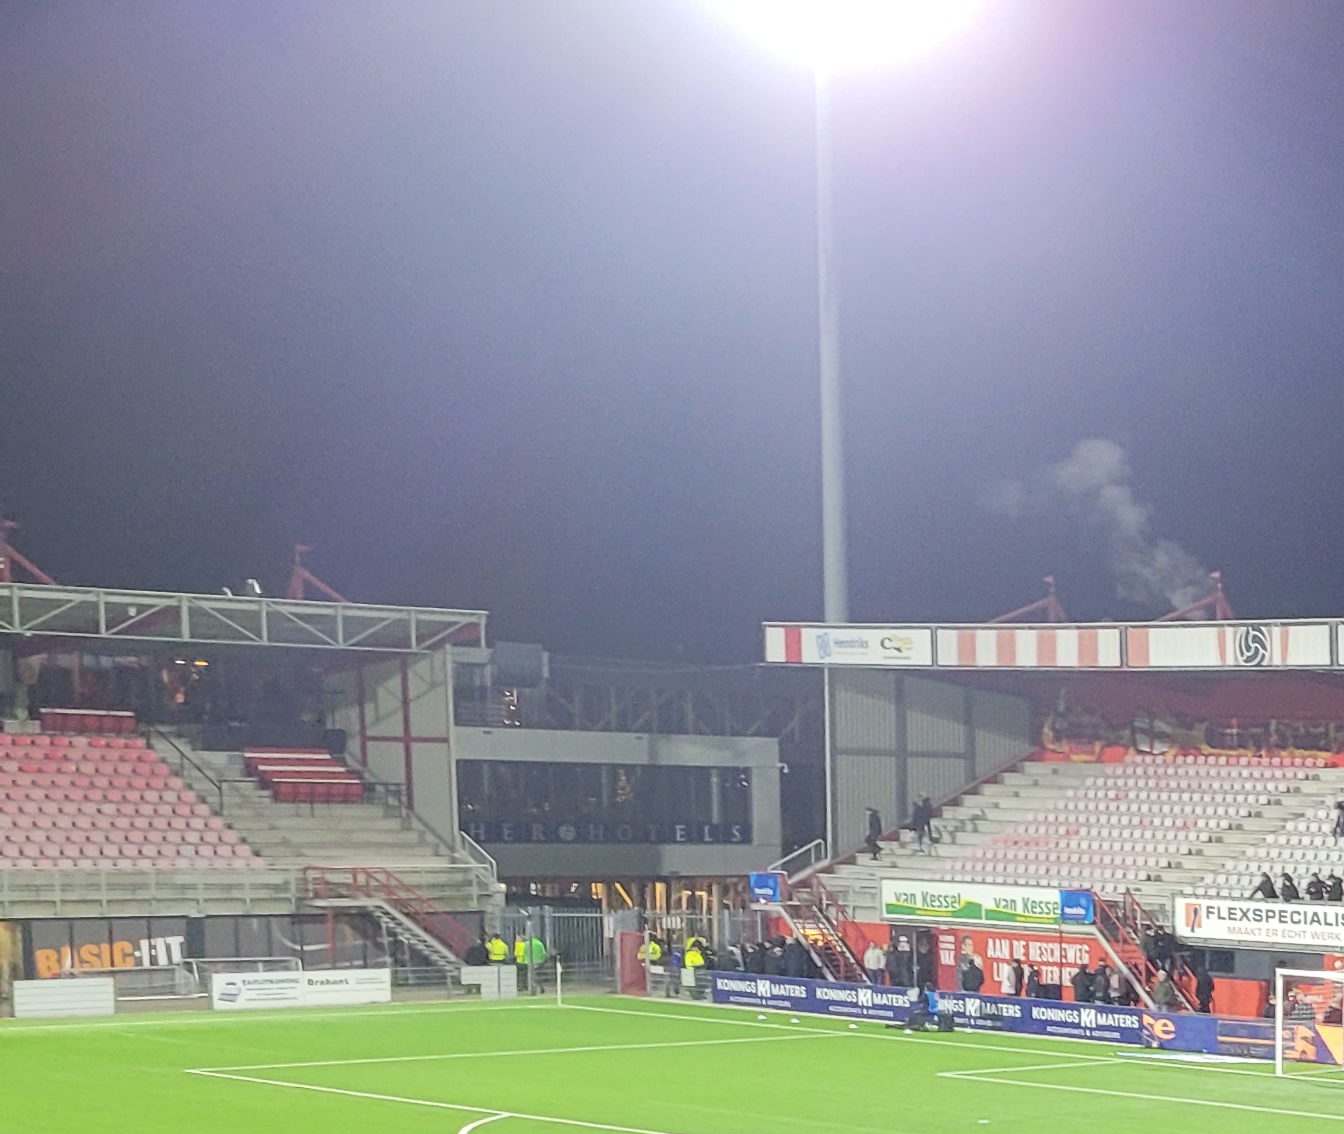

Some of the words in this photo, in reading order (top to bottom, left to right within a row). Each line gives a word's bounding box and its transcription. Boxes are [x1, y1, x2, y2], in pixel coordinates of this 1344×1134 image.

[894, 891, 917, 906] van
[921, 890, 961, 909] Kessel
[994, 897, 1017, 912] van
[1227, 925, 1263, 936] MAAKT
[1265, 928, 1279, 937] ER
[1311, 930, 1342, 942] WERK
[716, 977, 755, 994] KONINGS
[771, 983, 808, 998] MATERS
[816, 986, 857, 1002] KONINGS
[872, 991, 911, 1008] MATERS
[1031, 1006, 1079, 1024] KONINGS
[1096, 1012, 1139, 1029] MATERS
